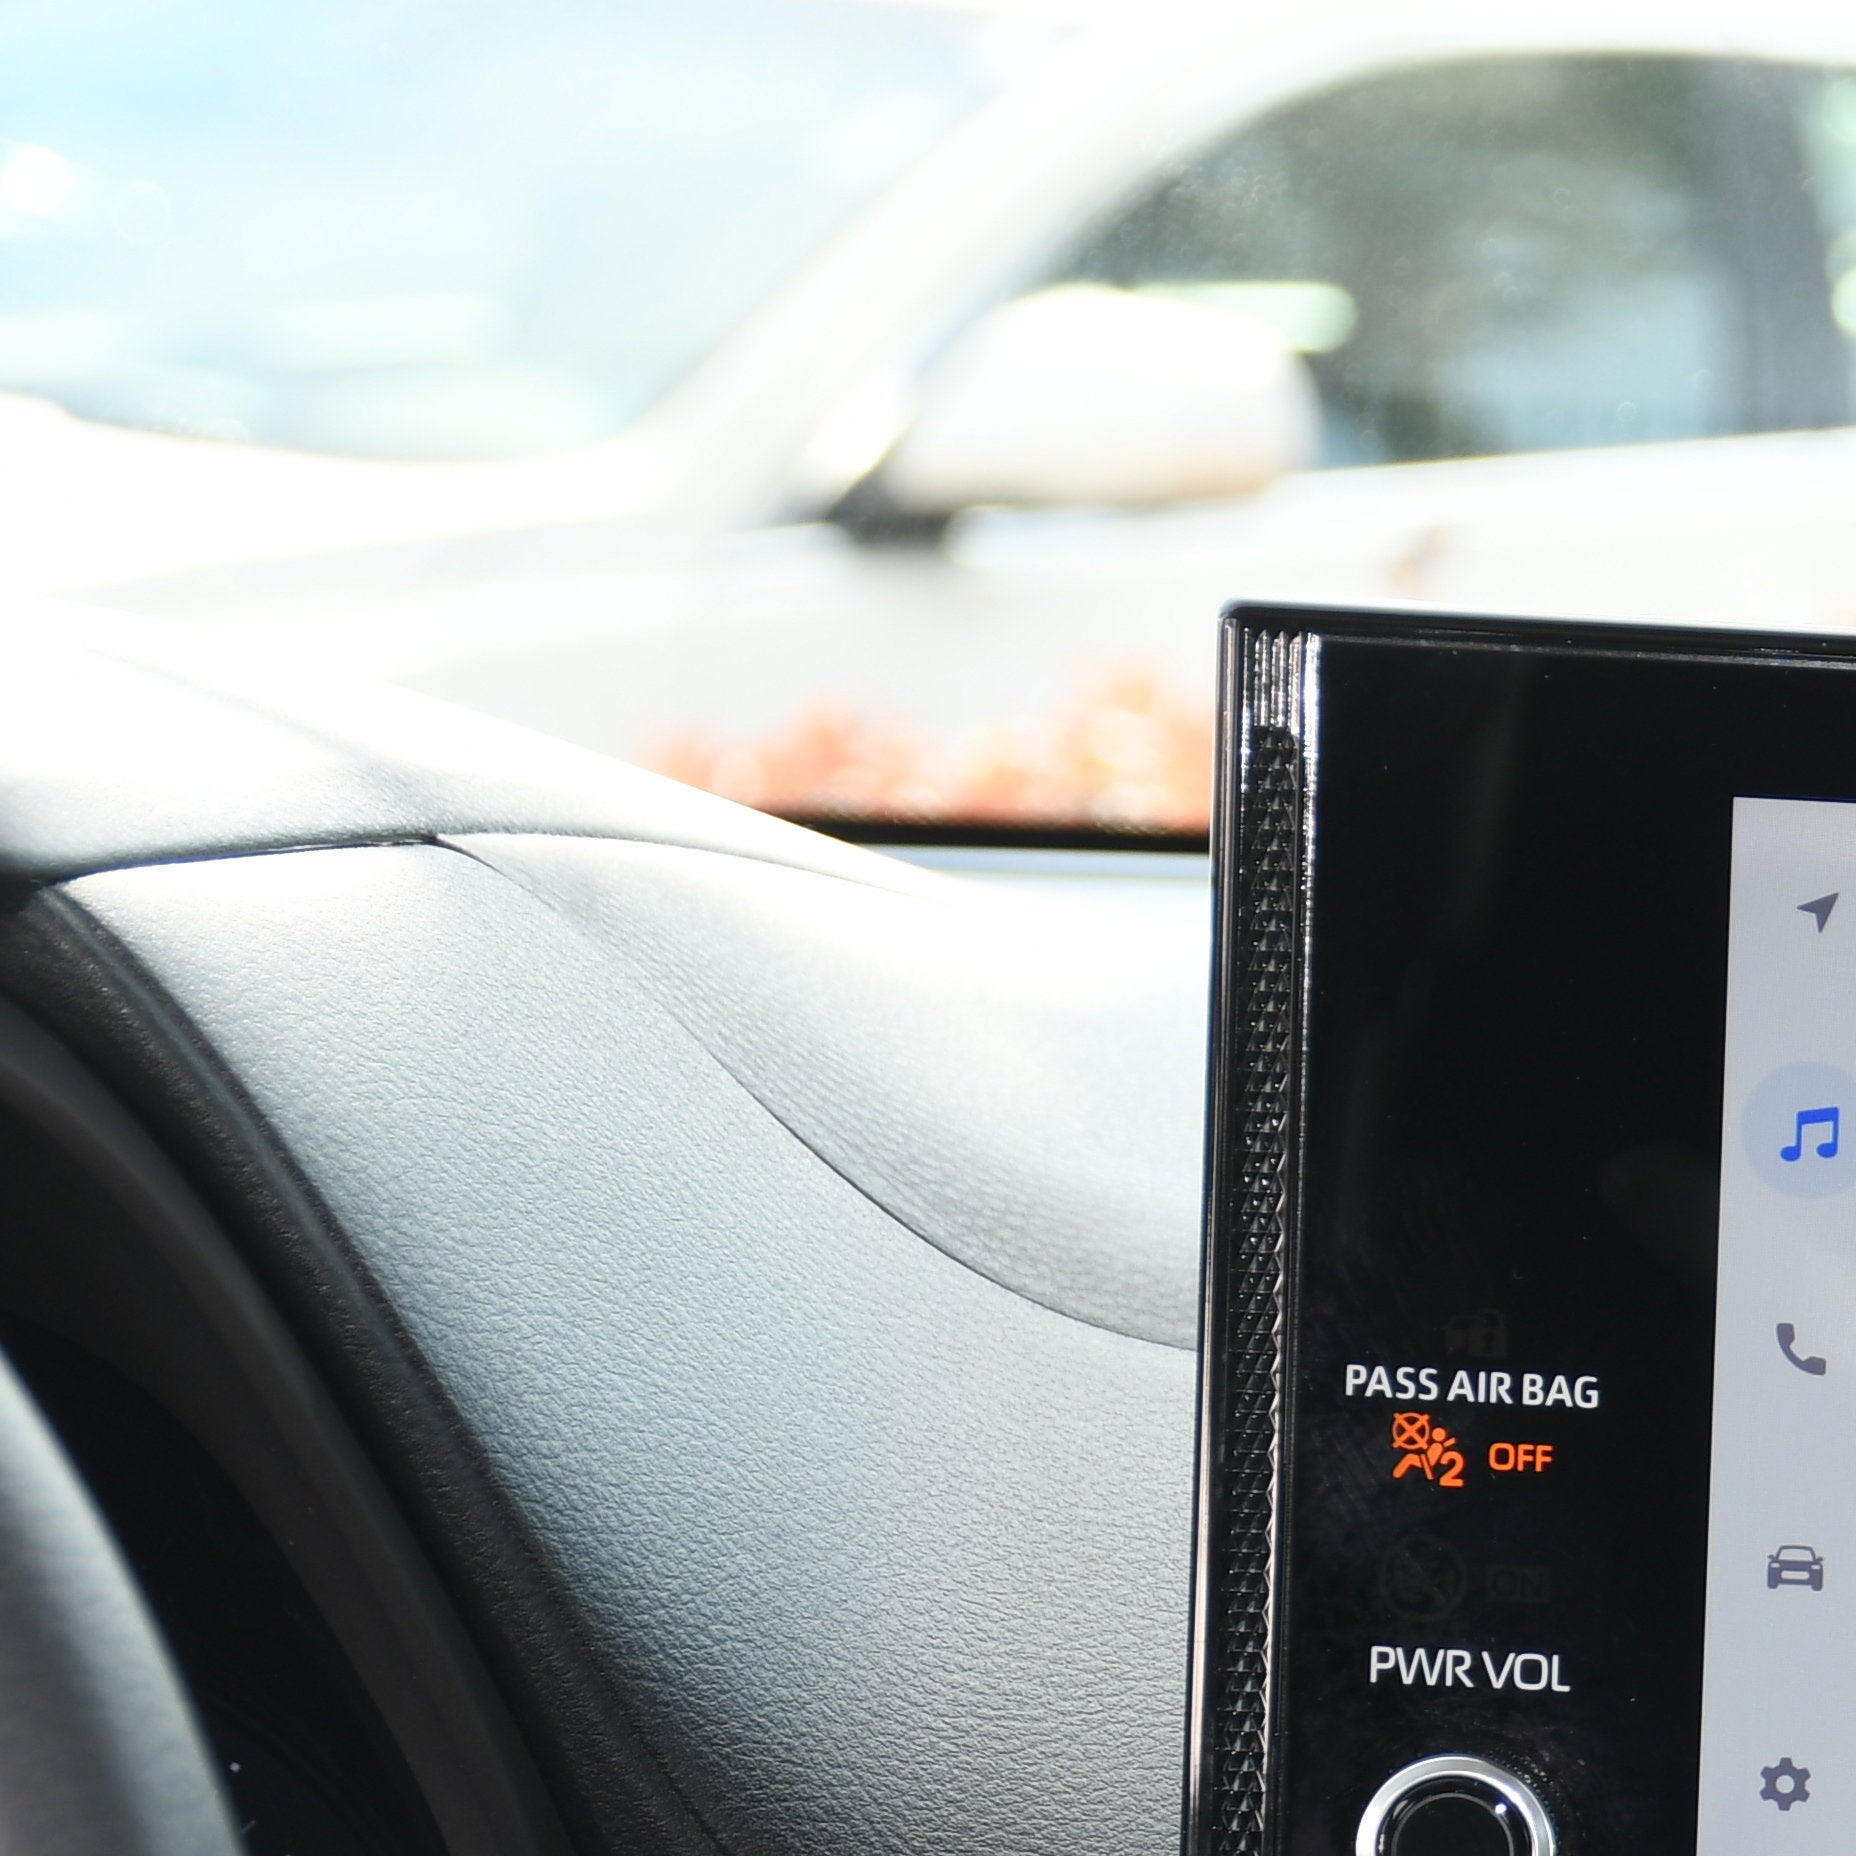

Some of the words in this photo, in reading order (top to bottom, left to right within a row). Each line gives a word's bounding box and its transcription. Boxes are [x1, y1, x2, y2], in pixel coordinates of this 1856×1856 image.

[1345, 1364, 1439, 1401] PASS
[1446, 1369, 1513, 1405] AIR
[1522, 1373, 1599, 1409] BAG
[1488, 1442, 1553, 1473] OFF
[1369, 1645, 1475, 1688] PWR
[1481, 1650, 1571, 1693] VOL
